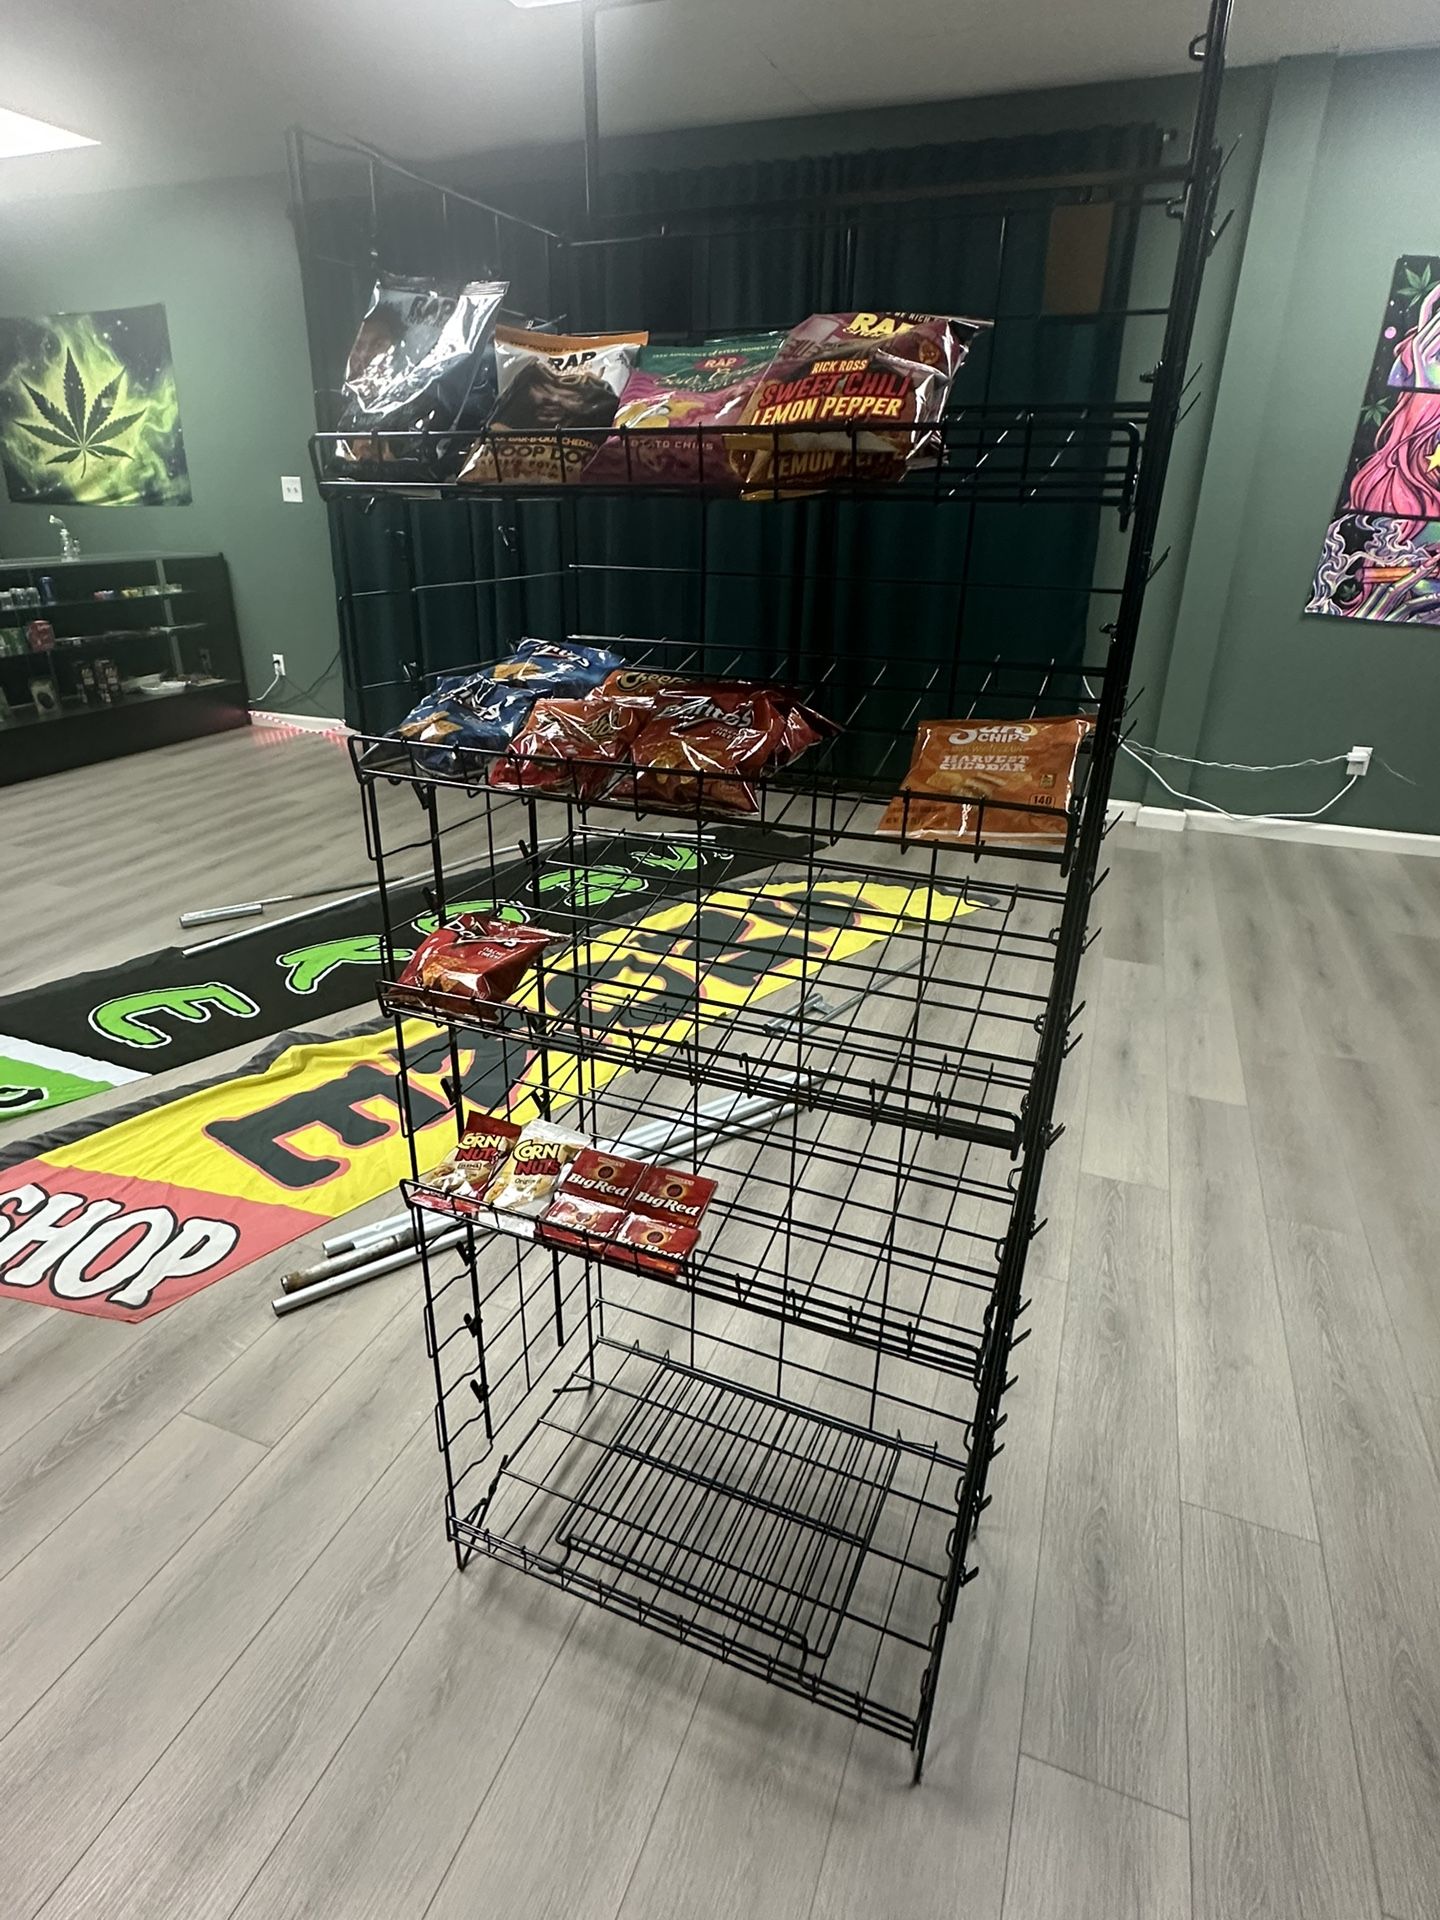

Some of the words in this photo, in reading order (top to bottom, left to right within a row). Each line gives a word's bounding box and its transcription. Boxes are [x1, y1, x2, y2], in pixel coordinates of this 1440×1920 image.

[547, 351, 597, 371] RAP
[703, 356, 737, 368] RAP
[811, 360, 836, 374] RICK
[839, 359, 869, 373] ROSS
[760, 373, 841, 407] SWEET
[844, 371, 914, 398] CHILI
[751, 398, 819, 426] LEMON
[820, 396, 903, 418] PEPPER
[676, 441, 714, 451] CHIS
[552, 446, 590, 464] DO
[977, 733, 1030, 743] CHIPS
[942, 754, 1029, 764] HARVEST
[938, 763, 1026, 772] CHEDDAR
[513, 1140, 560, 1162] CORN
[513, 1159, 562, 1176] NUTS
